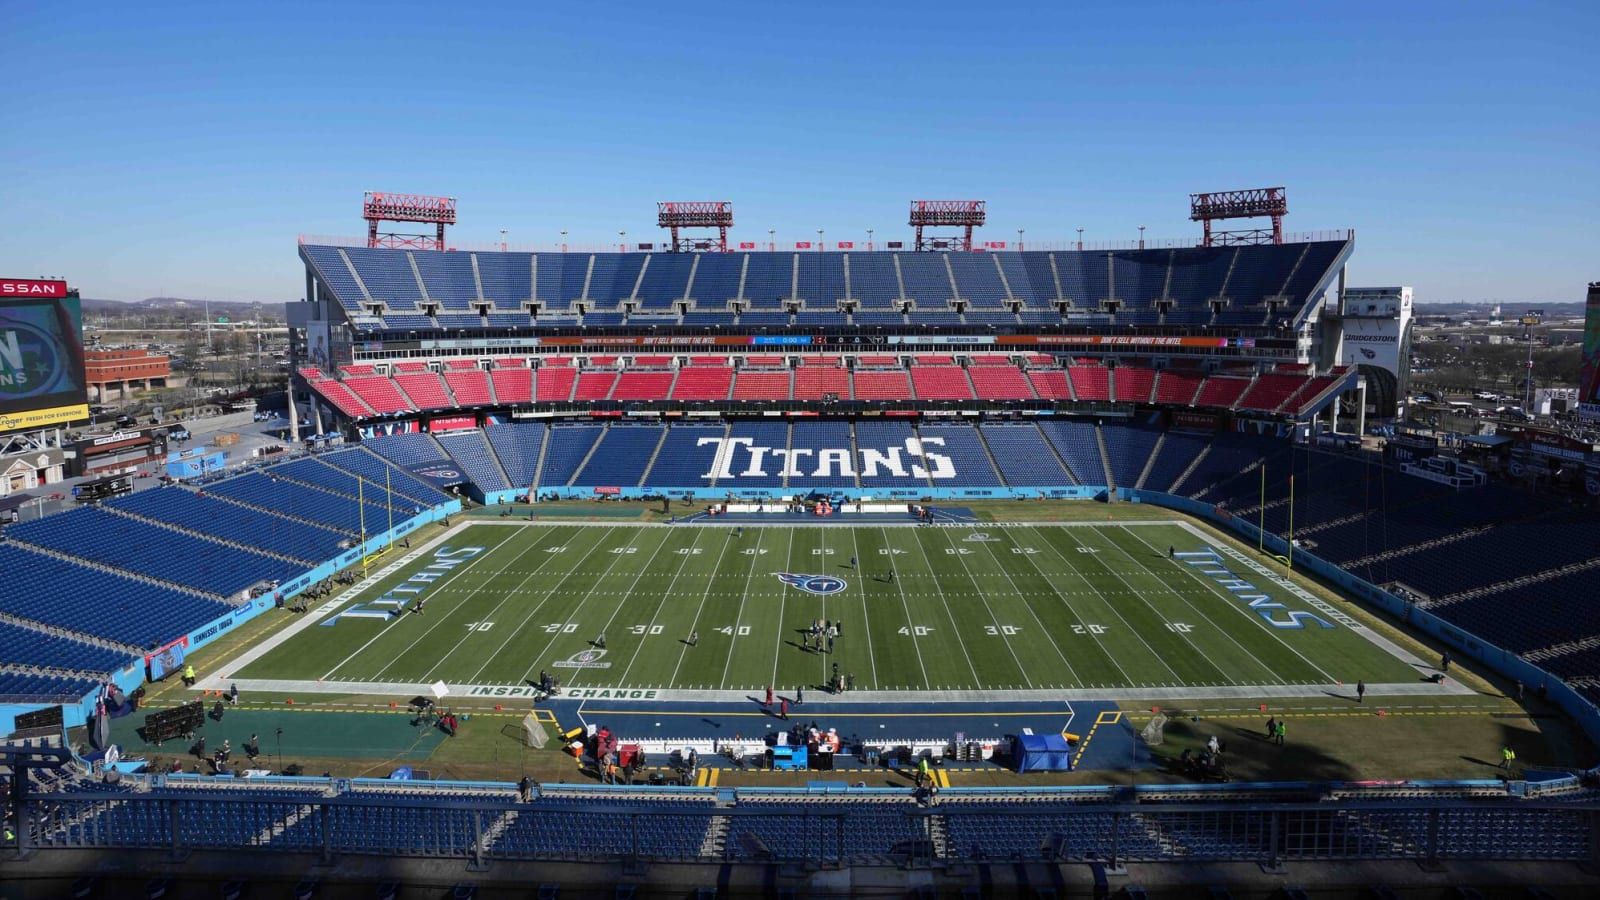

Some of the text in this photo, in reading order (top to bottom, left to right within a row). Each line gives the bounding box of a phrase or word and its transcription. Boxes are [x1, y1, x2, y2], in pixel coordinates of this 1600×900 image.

[2, 283, 55, 294] SSAN
[1344, 334, 1397, 342] BRIDGESTONE
[1544, 389, 1576, 400] NISS
[1303, 595, 1362, 628] JUSTICE
[193, 625, 218, 645] TENNESSEE
[219, 618, 233, 631] TOUGH
[468, 622, 495, 632] 10
[549, 623, 580, 633] 20
[631, 624, 665, 635] 30
[719, 625, 752, 636] 40
[898, 626, 928, 636] 40
[984, 625, 1017, 635] 30
[1070, 624, 1105, 634] 20
[1164, 623, 1192, 633] 10
[470, 687, 657, 699] INSPIR CHANGE
